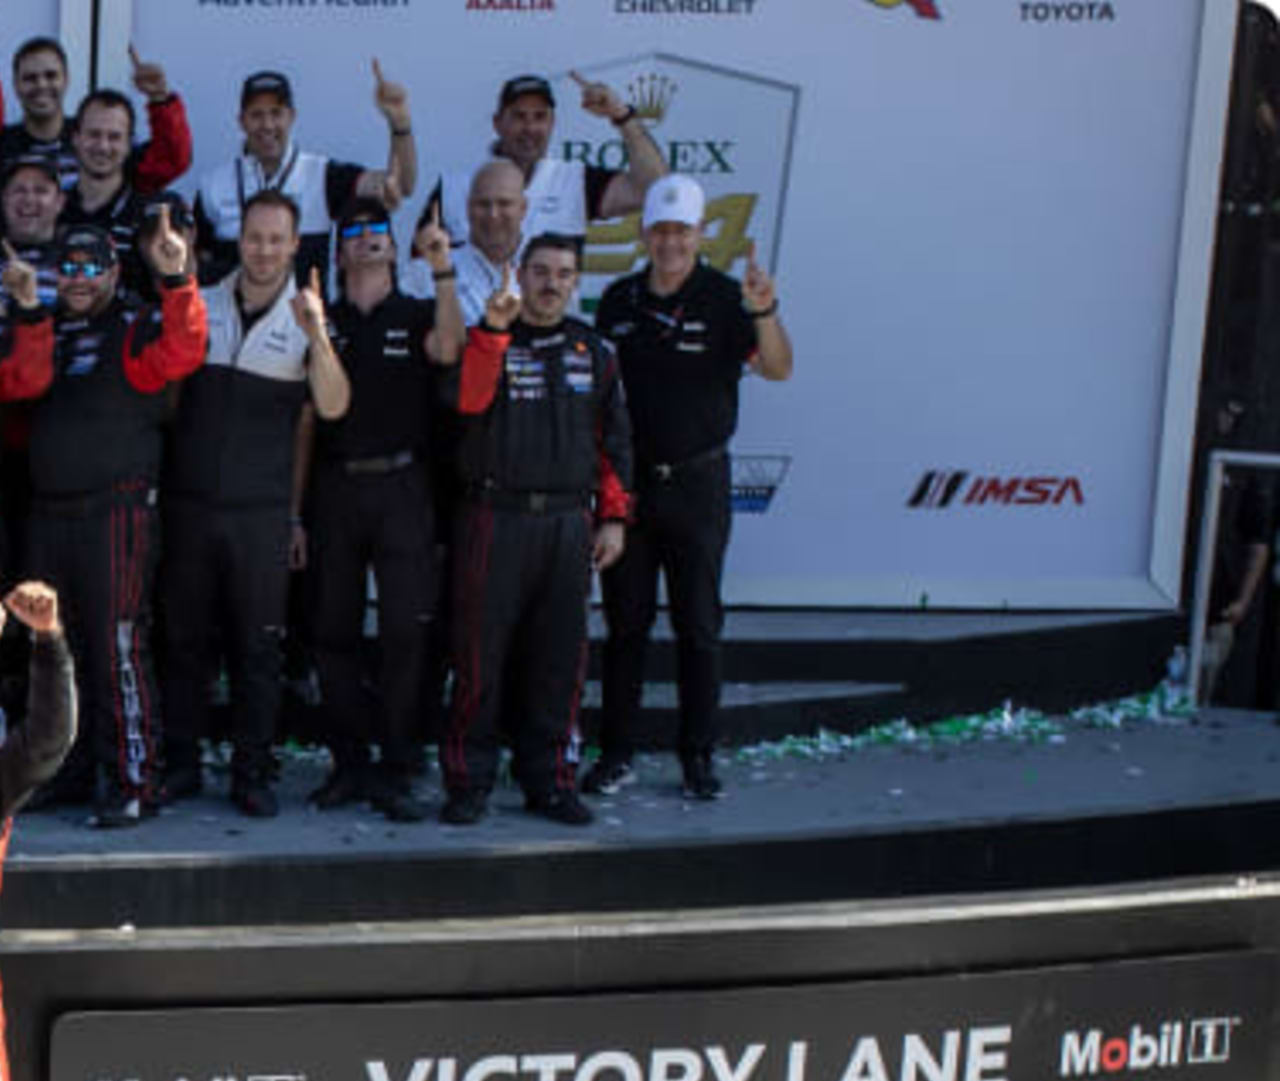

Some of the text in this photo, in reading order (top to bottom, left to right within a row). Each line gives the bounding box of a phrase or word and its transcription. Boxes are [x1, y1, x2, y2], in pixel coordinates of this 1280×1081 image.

[1019, 2, 1116, 22] TOYOTA
[561, 140, 738, 175] ROEX
[961, 476, 1085, 507] IMSA
[1059, 1021, 1183, 1077] Mobil
